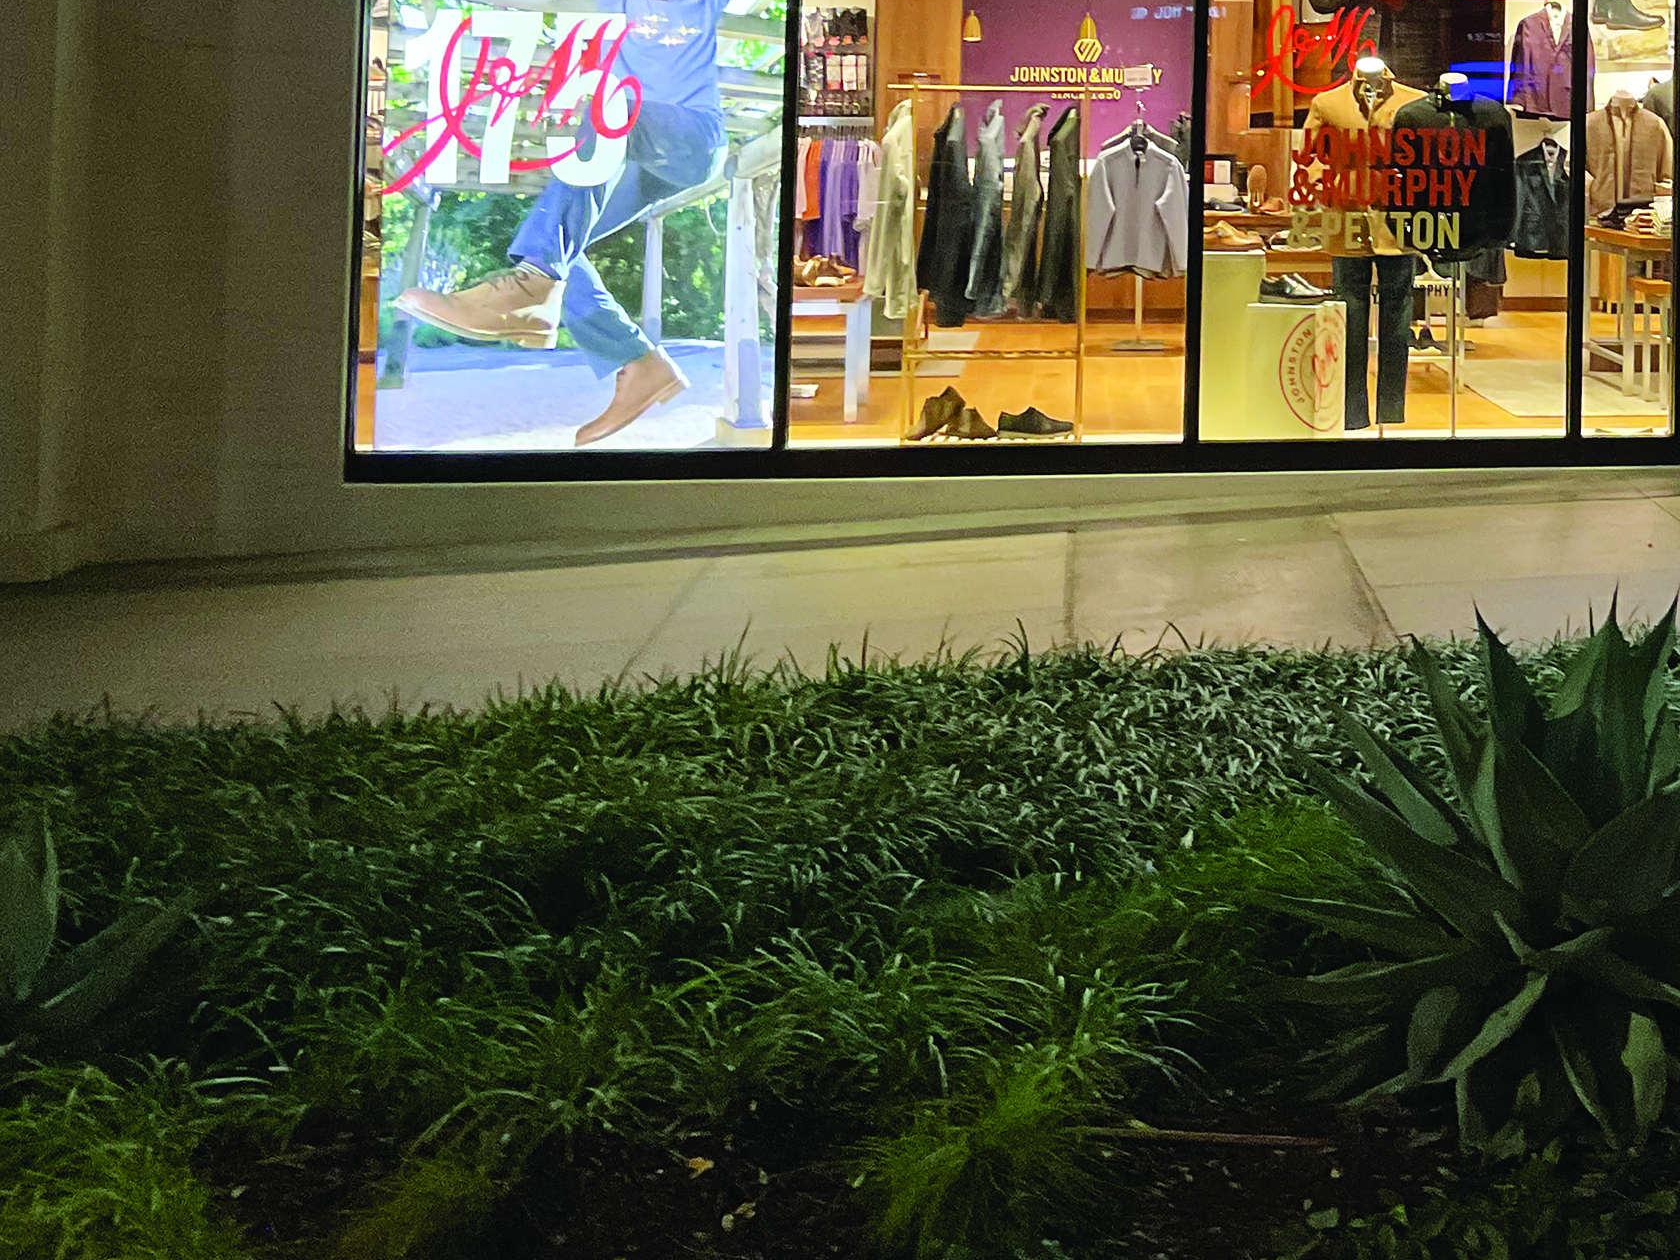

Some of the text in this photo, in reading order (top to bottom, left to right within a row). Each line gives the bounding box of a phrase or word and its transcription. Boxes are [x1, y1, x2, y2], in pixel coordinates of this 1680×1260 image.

[1009, 66, 1087, 84] JOHNSTON
[403, 8, 628, 187] 175
[1292, 125, 1486, 167] JOHNSTON
